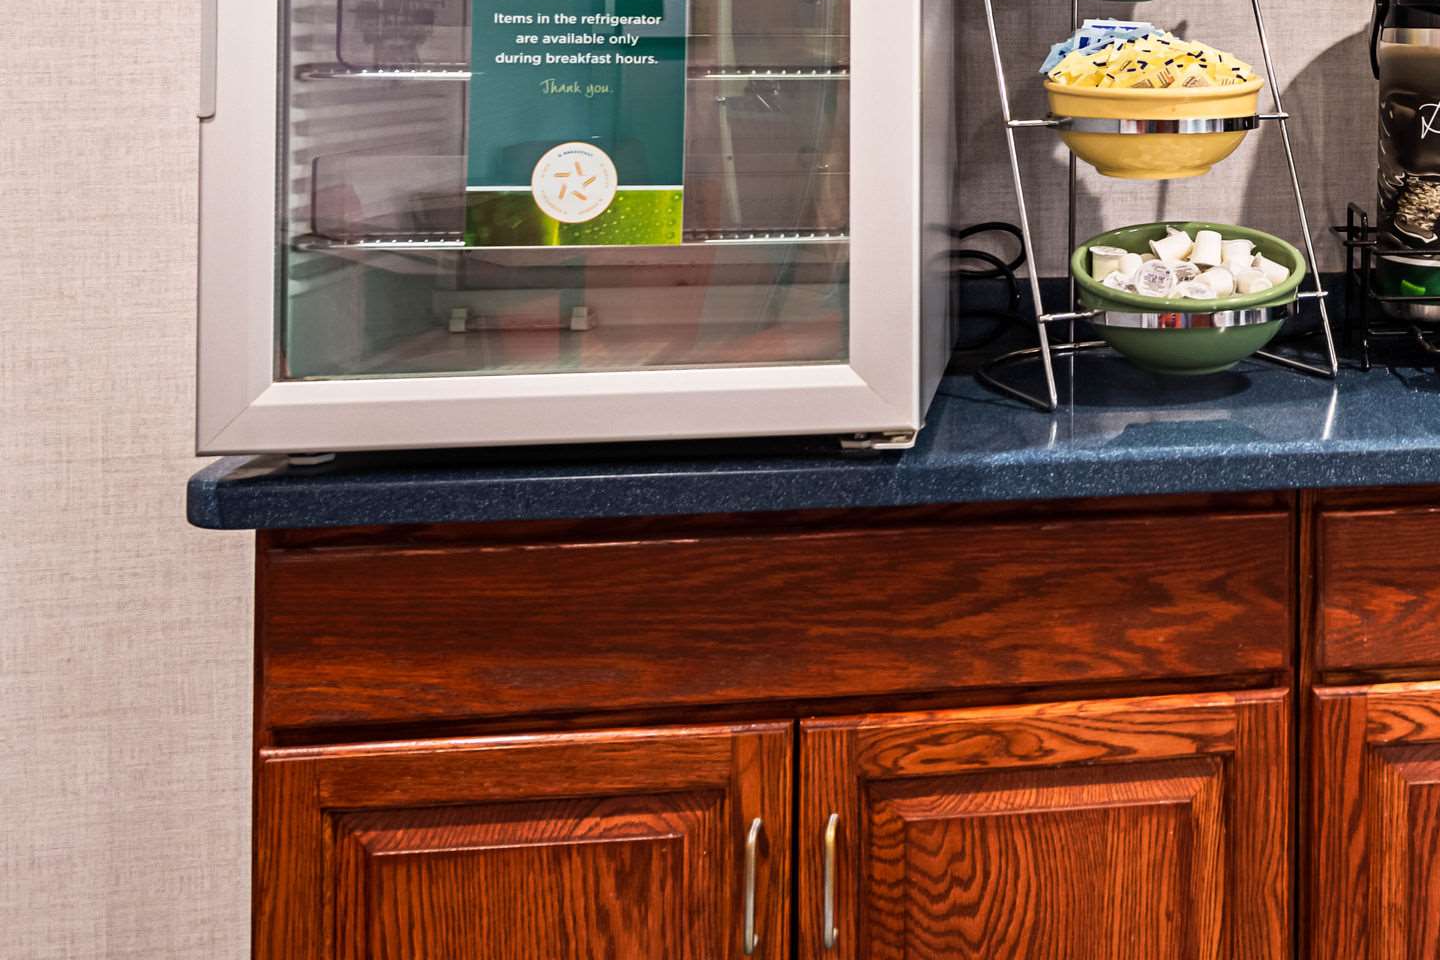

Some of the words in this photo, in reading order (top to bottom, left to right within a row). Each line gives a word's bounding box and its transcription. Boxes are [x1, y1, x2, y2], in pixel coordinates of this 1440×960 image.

[494, 13, 533, 24] Items
[537, 13, 550, 24] in
[554, 13, 577, 24] the
[581, 13, 662, 27] refrigerator
[515, 34, 538, 44] are
[542, 33, 605, 44] available
[608, 34, 639, 47] only
[495, 52, 541, 66] during
[545, 52, 612, 64] breakfast
[615, 53, 659, 65] hours.
[539, 78, 582, 94] Thank
